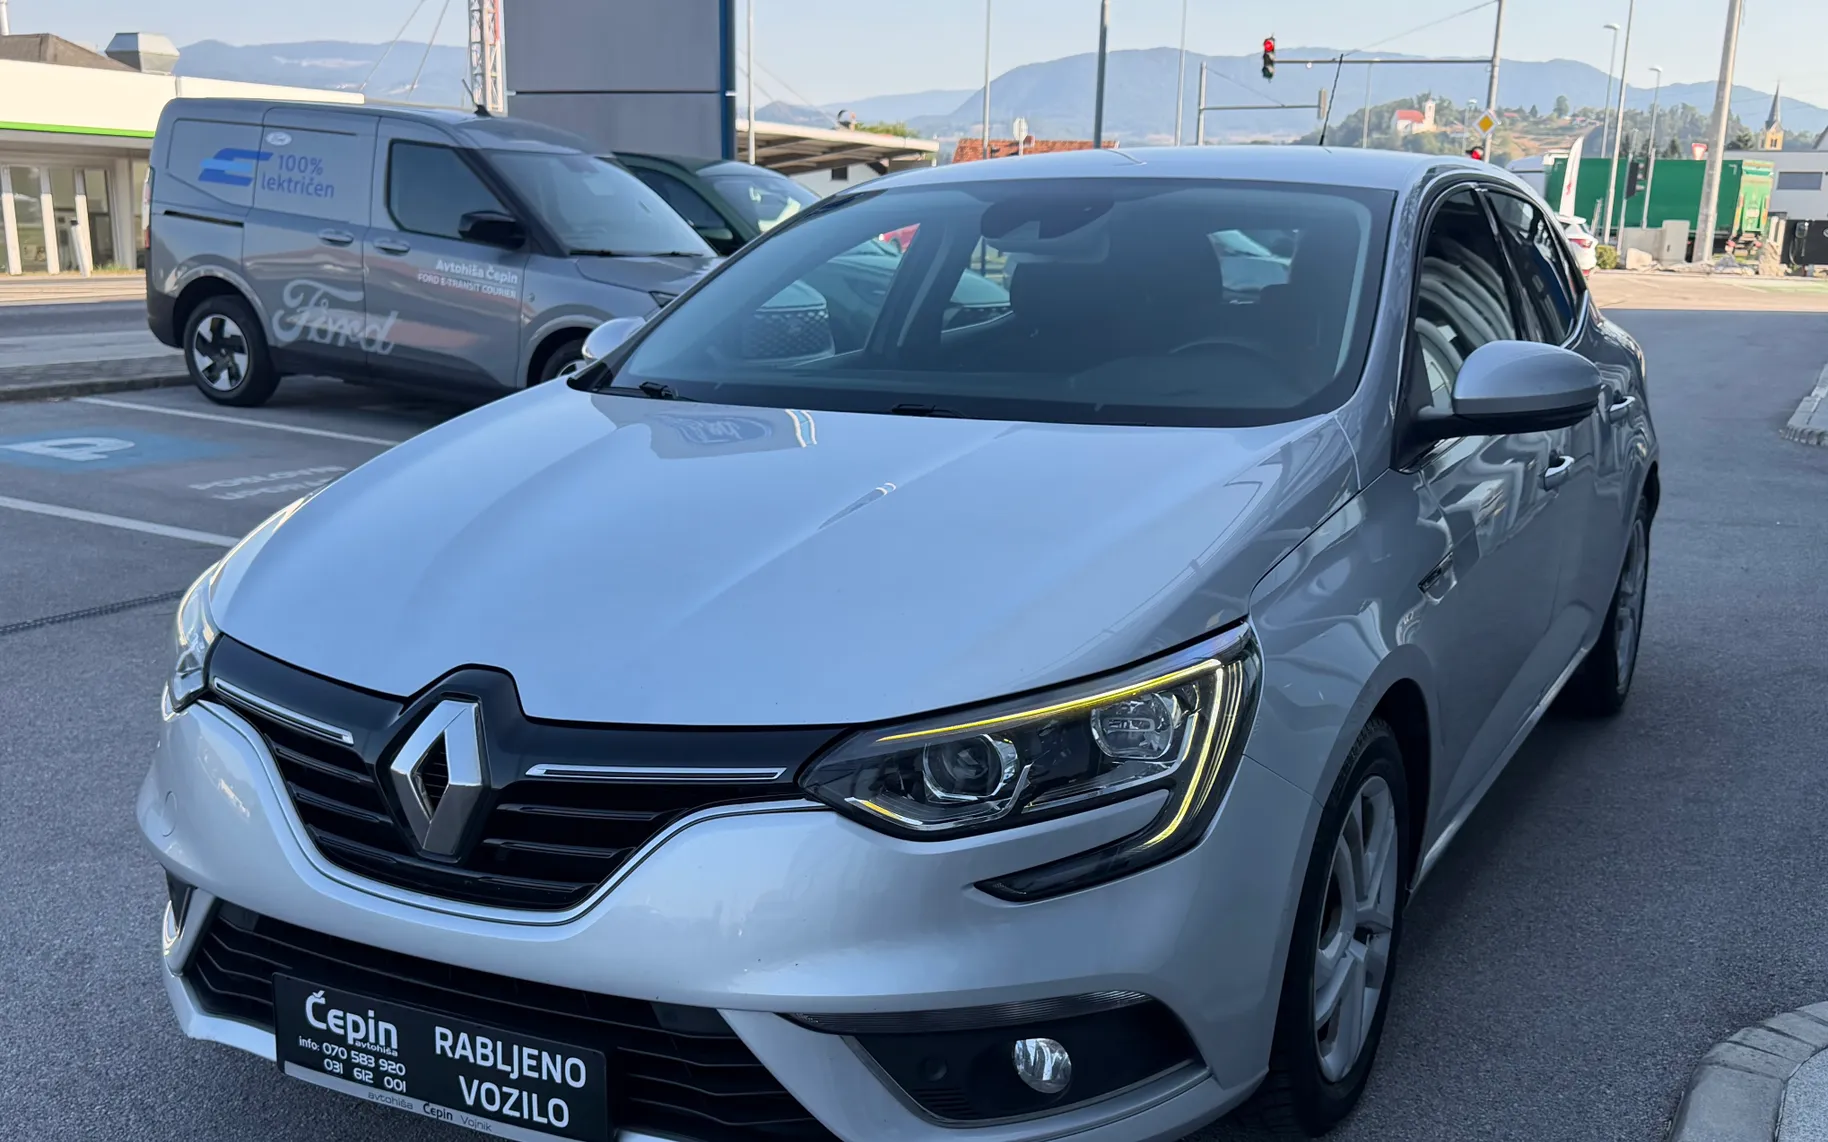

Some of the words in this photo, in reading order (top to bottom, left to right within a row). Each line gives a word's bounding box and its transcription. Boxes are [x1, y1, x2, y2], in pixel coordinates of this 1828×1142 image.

[278, 154, 324, 176] 100%
[260, 172, 335, 199] lektričen
[418, 273, 440, 285] FORD
[481, 285, 517, 299] COURIER
[487, 265, 518, 284] Čepin
[272, 279, 399, 355] Ford
[305, 990, 398, 1049] Čepin
[298, 1035, 320, 1052] info:
[322, 1042, 348, 1060] 070
[350, 1050, 376, 1068] 583
[378, 1058, 406, 1076] 920
[354, 1040, 399, 1057] avtohiša
[434, 1025, 587, 1089] RABLJENO
[323, 1058, 344, 1074] 031
[353, 1067, 374, 1084] 612
[383, 1076, 407, 1093] 001
[422, 1101, 454, 1121] Čepin
[460, 1114, 493, 1132] Vojnik
[458, 1075, 570, 1129] VOZILO
